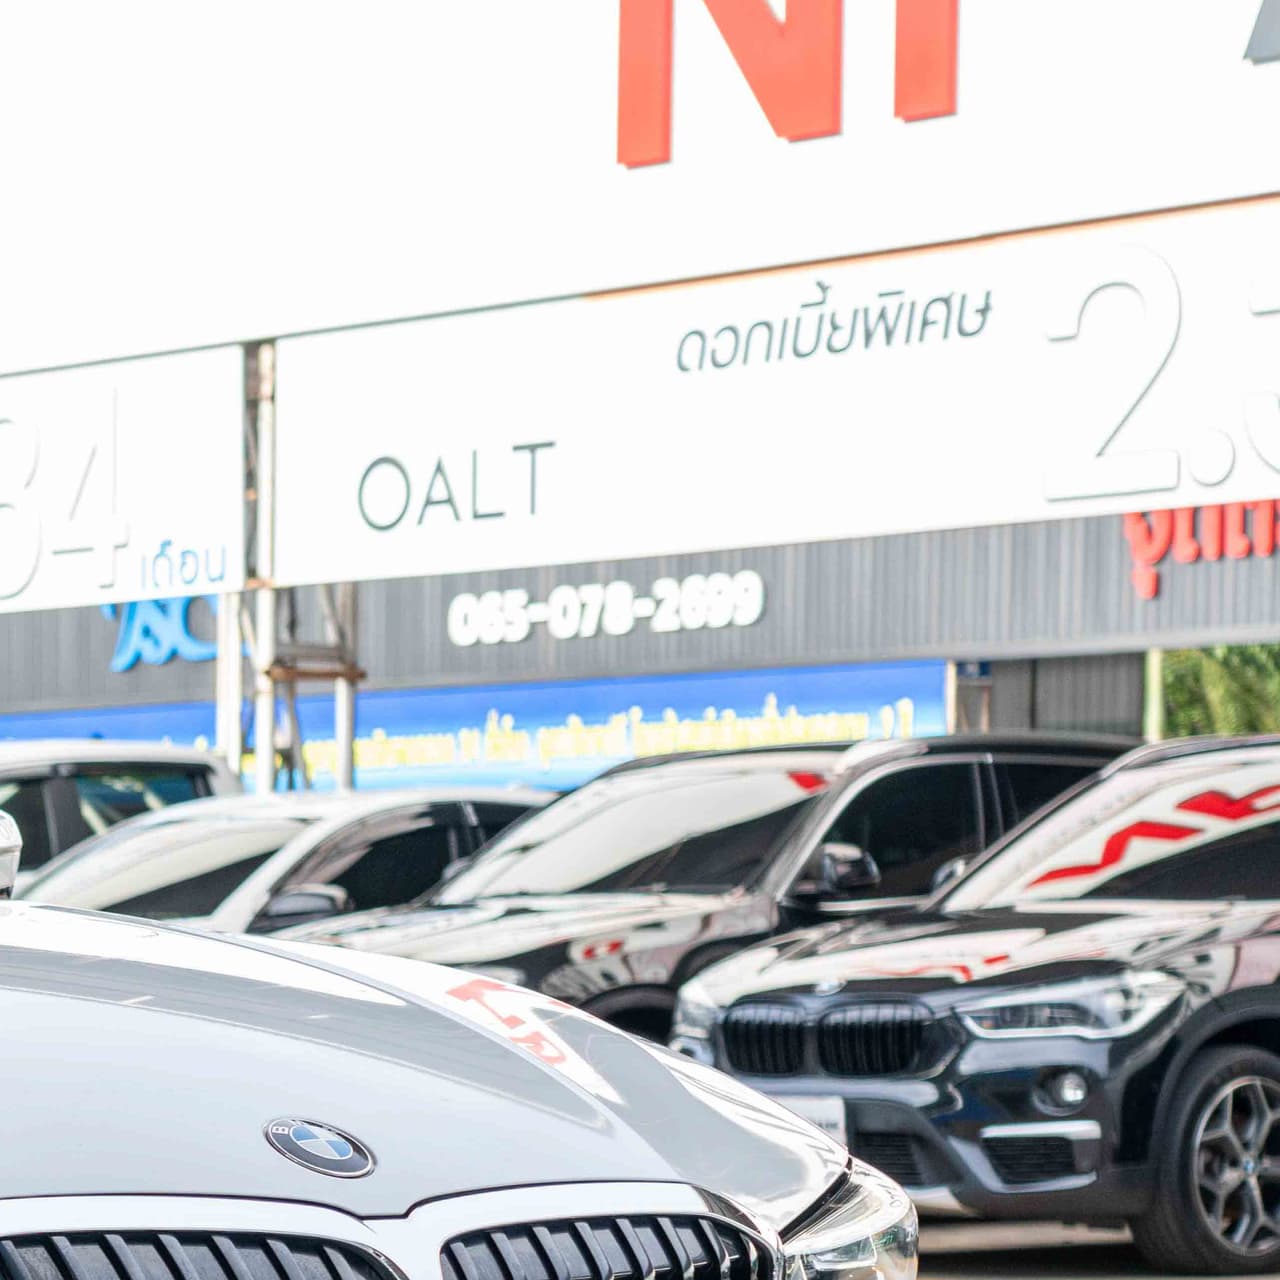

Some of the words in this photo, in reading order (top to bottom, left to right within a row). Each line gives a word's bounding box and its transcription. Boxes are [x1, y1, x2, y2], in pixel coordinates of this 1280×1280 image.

[617, 0, 957, 168] N
[676, 280, 993, 373] ดอกเบี้ยพิเศษ
[358, 440, 556, 531] OALT
